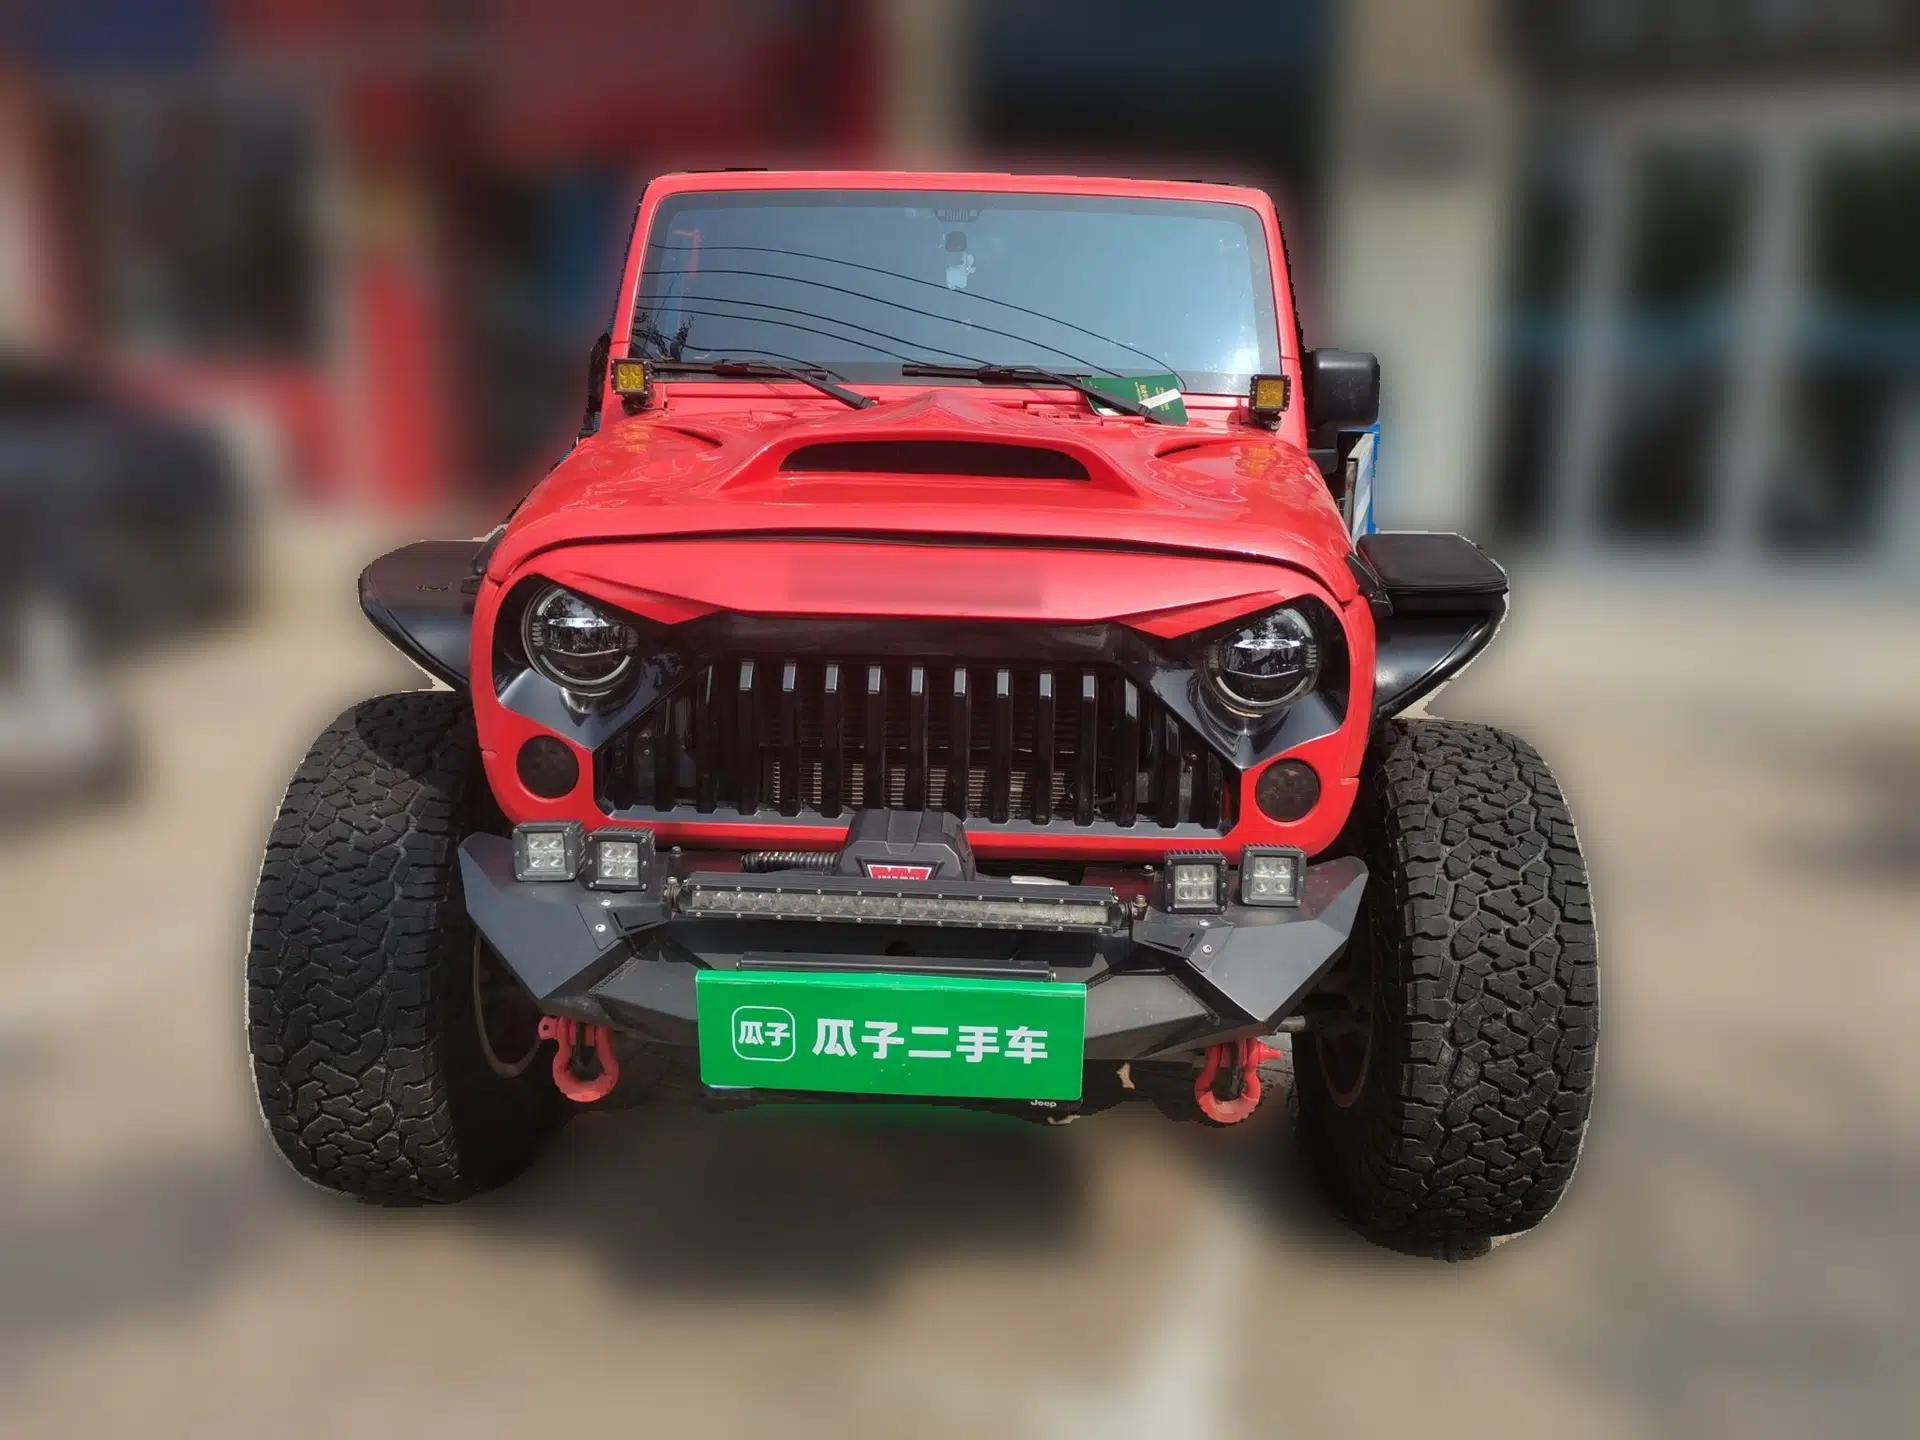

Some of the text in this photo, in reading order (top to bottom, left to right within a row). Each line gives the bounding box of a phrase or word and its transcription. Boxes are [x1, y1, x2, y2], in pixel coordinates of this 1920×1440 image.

[737, 1020, 790, 1046] 瓜子
[812, 1018, 1048, 1064] 瓜子二手车
[1030, 1099, 1057, 1109] Jeep
